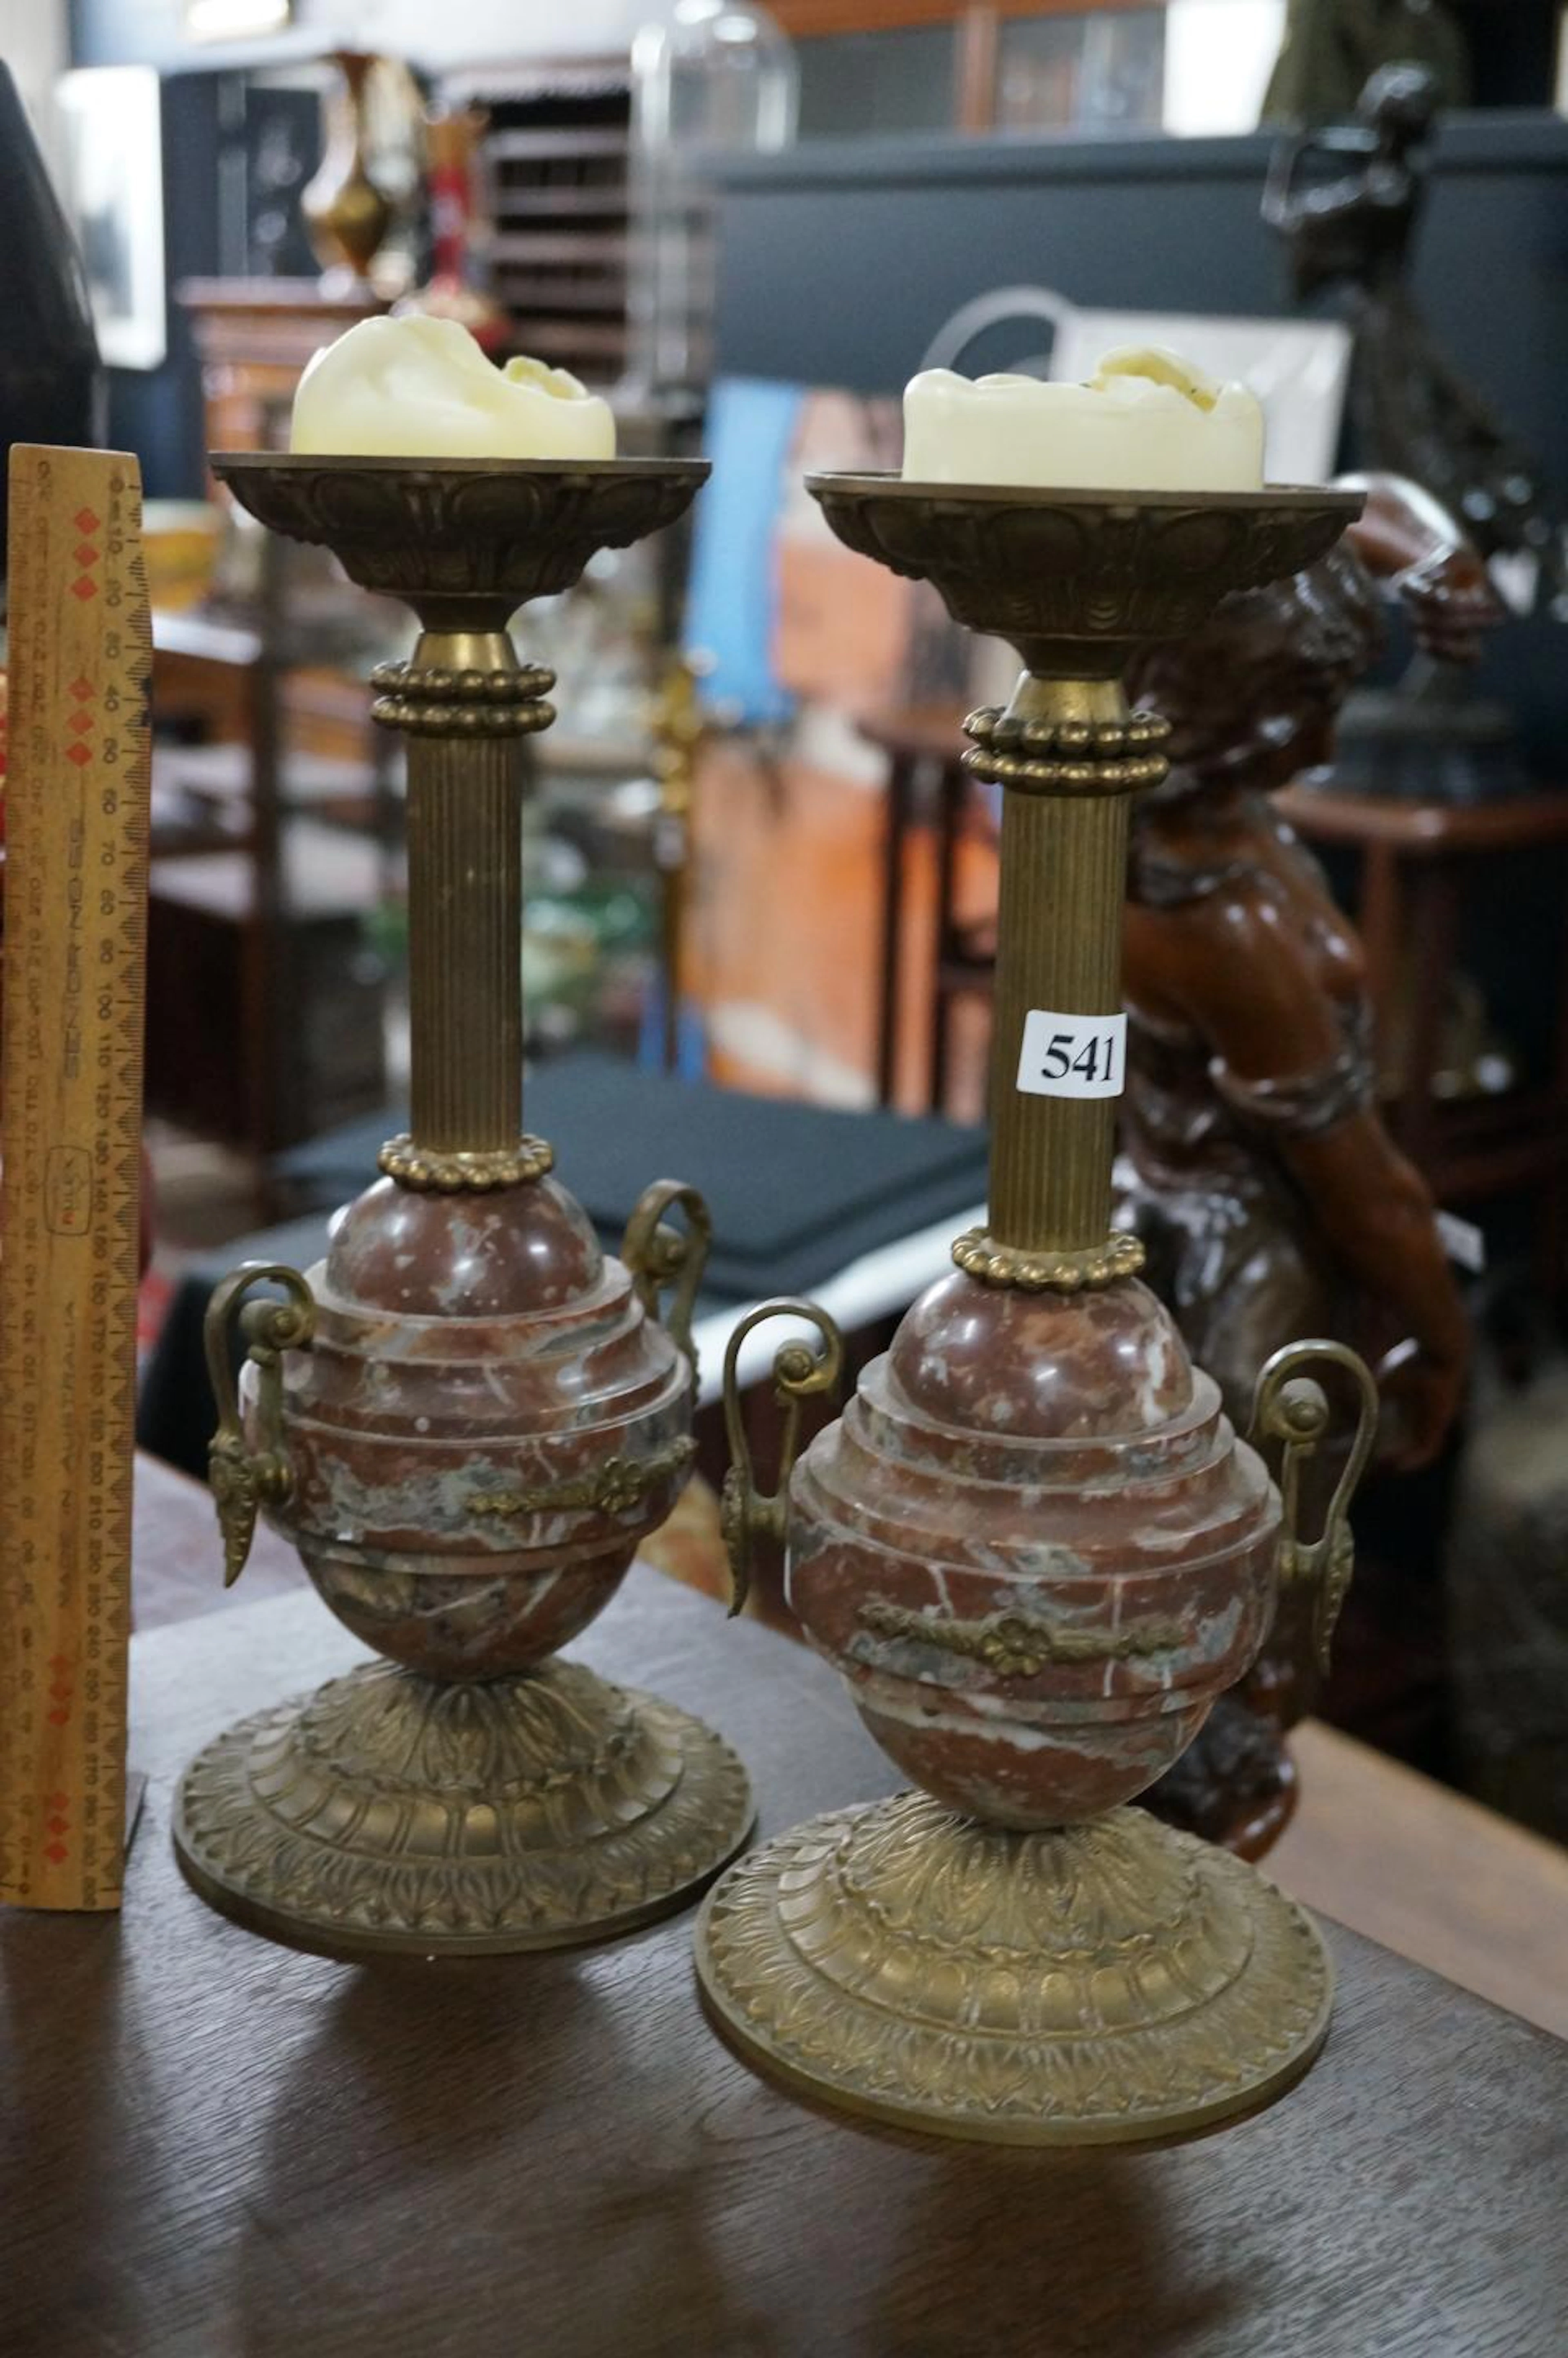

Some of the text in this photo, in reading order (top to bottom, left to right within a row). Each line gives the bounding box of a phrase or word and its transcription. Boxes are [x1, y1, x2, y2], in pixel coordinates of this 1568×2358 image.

[104, 687, 120, 712] 40
[100, 840, 114, 866] 70
[98, 983, 112, 1020] 100
[98, 1033, 111, 1067] 110
[1041, 1035, 1114, 1081] 541
